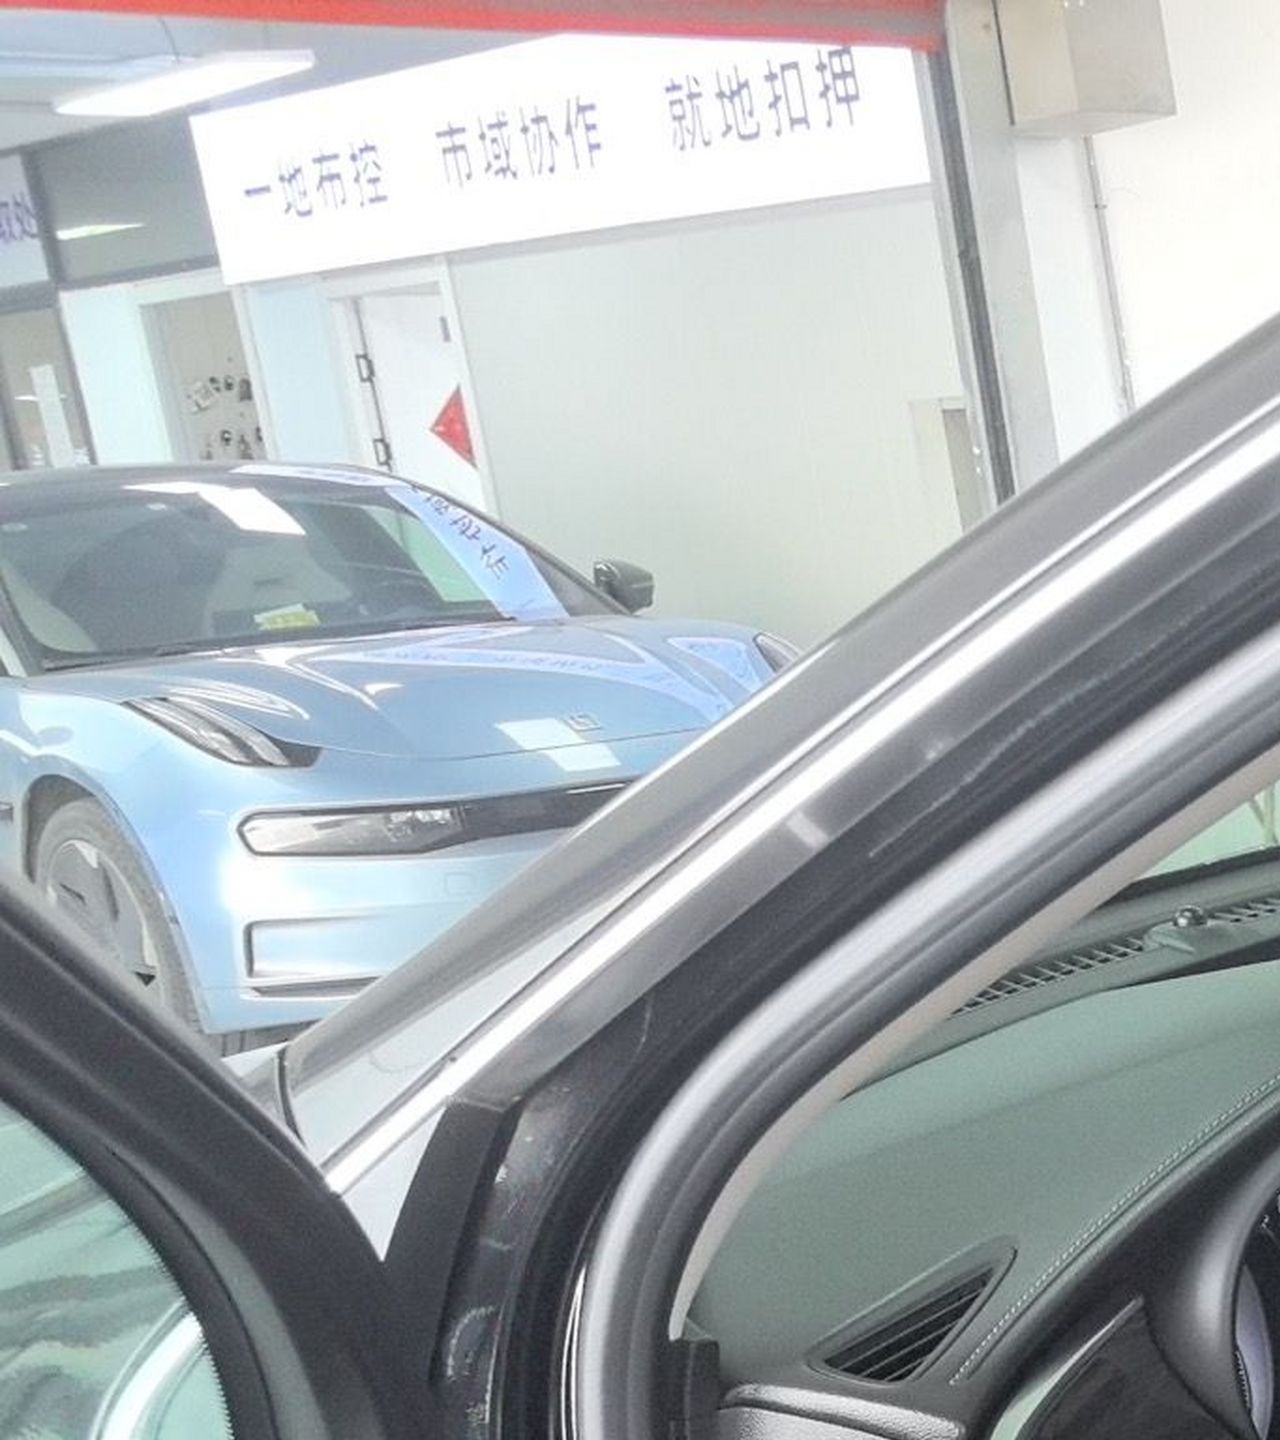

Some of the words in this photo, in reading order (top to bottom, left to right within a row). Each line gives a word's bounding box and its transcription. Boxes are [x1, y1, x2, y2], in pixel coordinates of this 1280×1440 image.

[244, 139, 388, 218] 一地布控
[434, 95, 602, 188] 市域协作
[663, 46, 860, 151] 就地扣押
